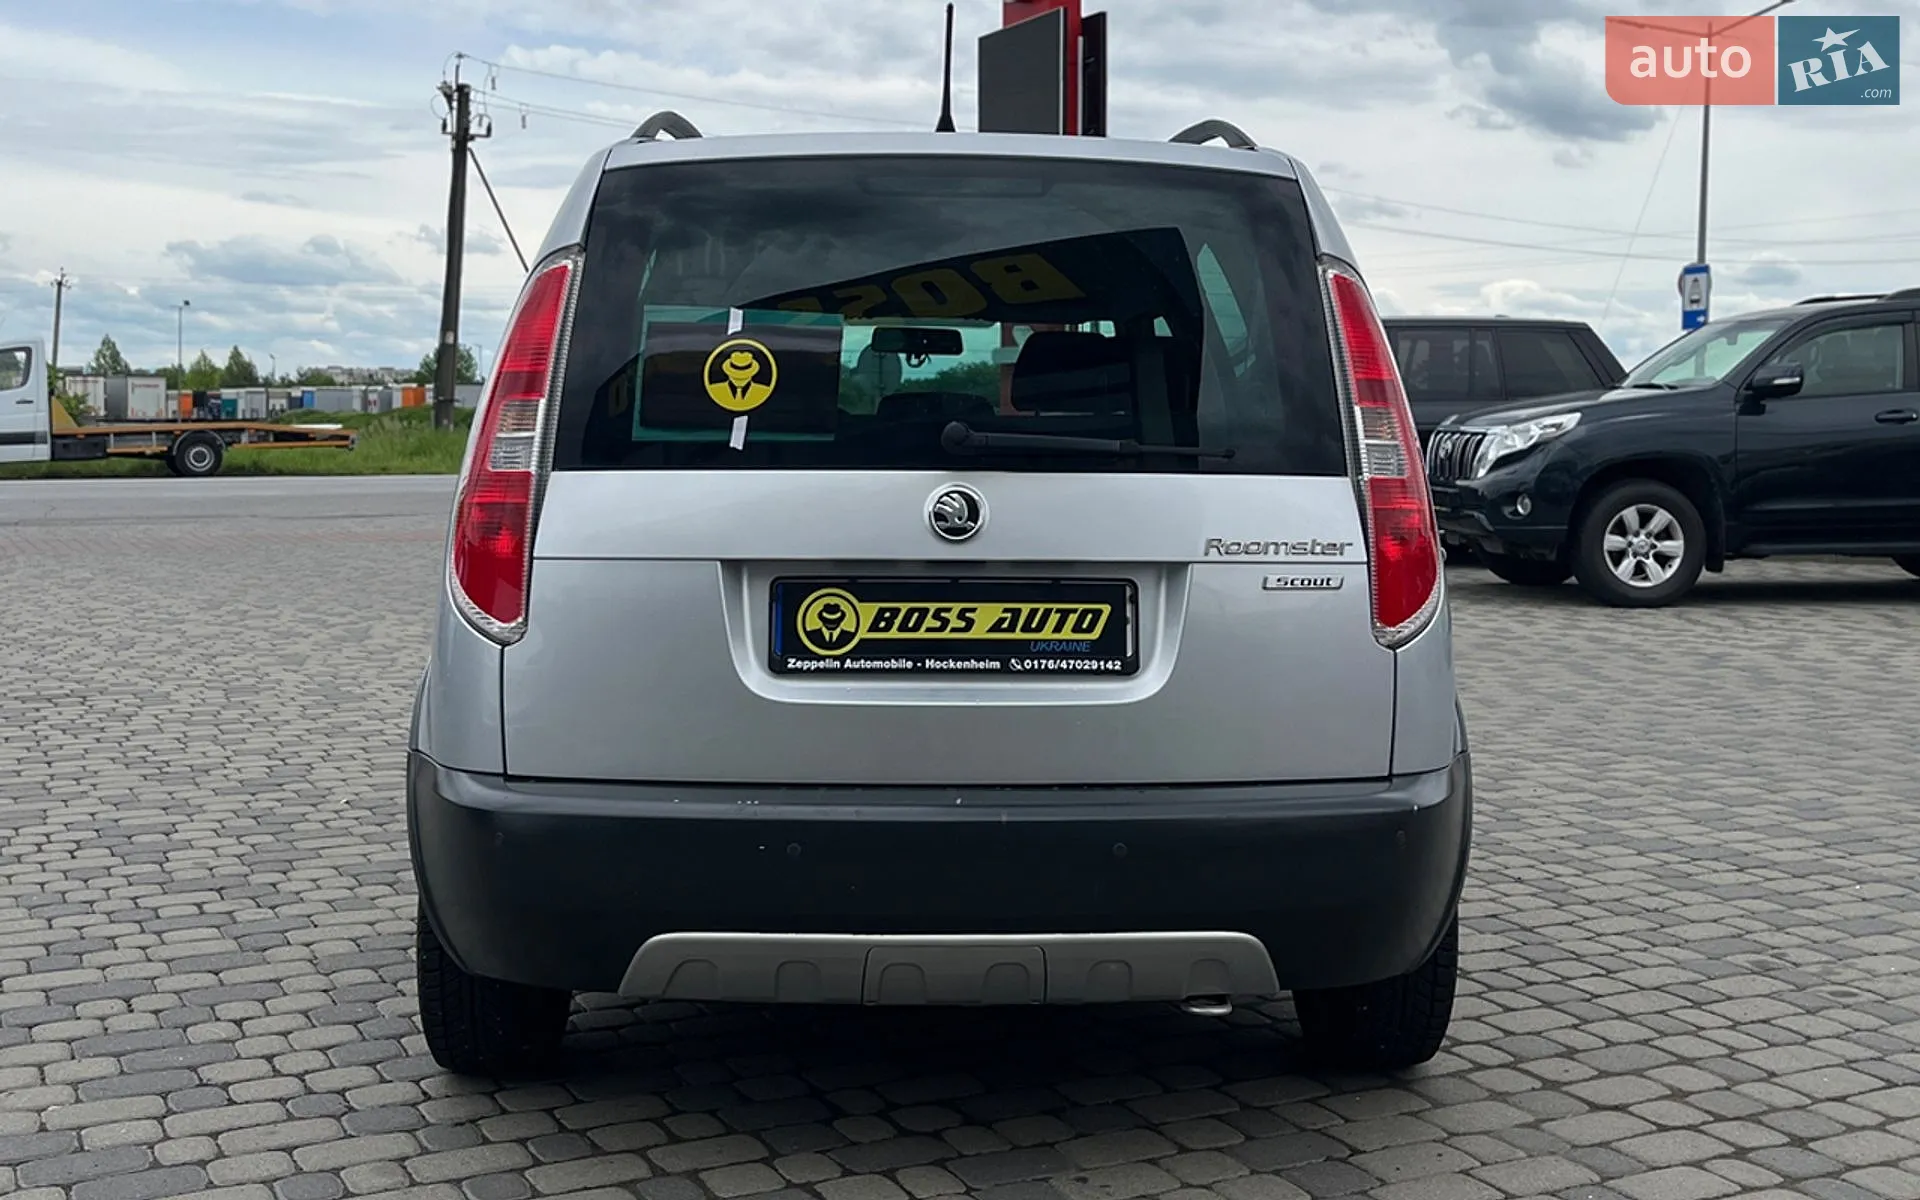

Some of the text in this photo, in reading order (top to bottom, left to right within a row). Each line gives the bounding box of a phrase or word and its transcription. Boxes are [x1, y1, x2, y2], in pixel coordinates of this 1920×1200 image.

[1203, 538, 1354, 556] Roomster
[1275, 576, 1333, 587] Scout
[866, 606, 1105, 634] BOSS AUTO
[1029, 640, 1093, 653] UKRAINE
[786, 657, 841, 671] Zeppelin
[843, 657, 914, 670] Automobile
[925, 657, 1001, 670] Hockenheim
